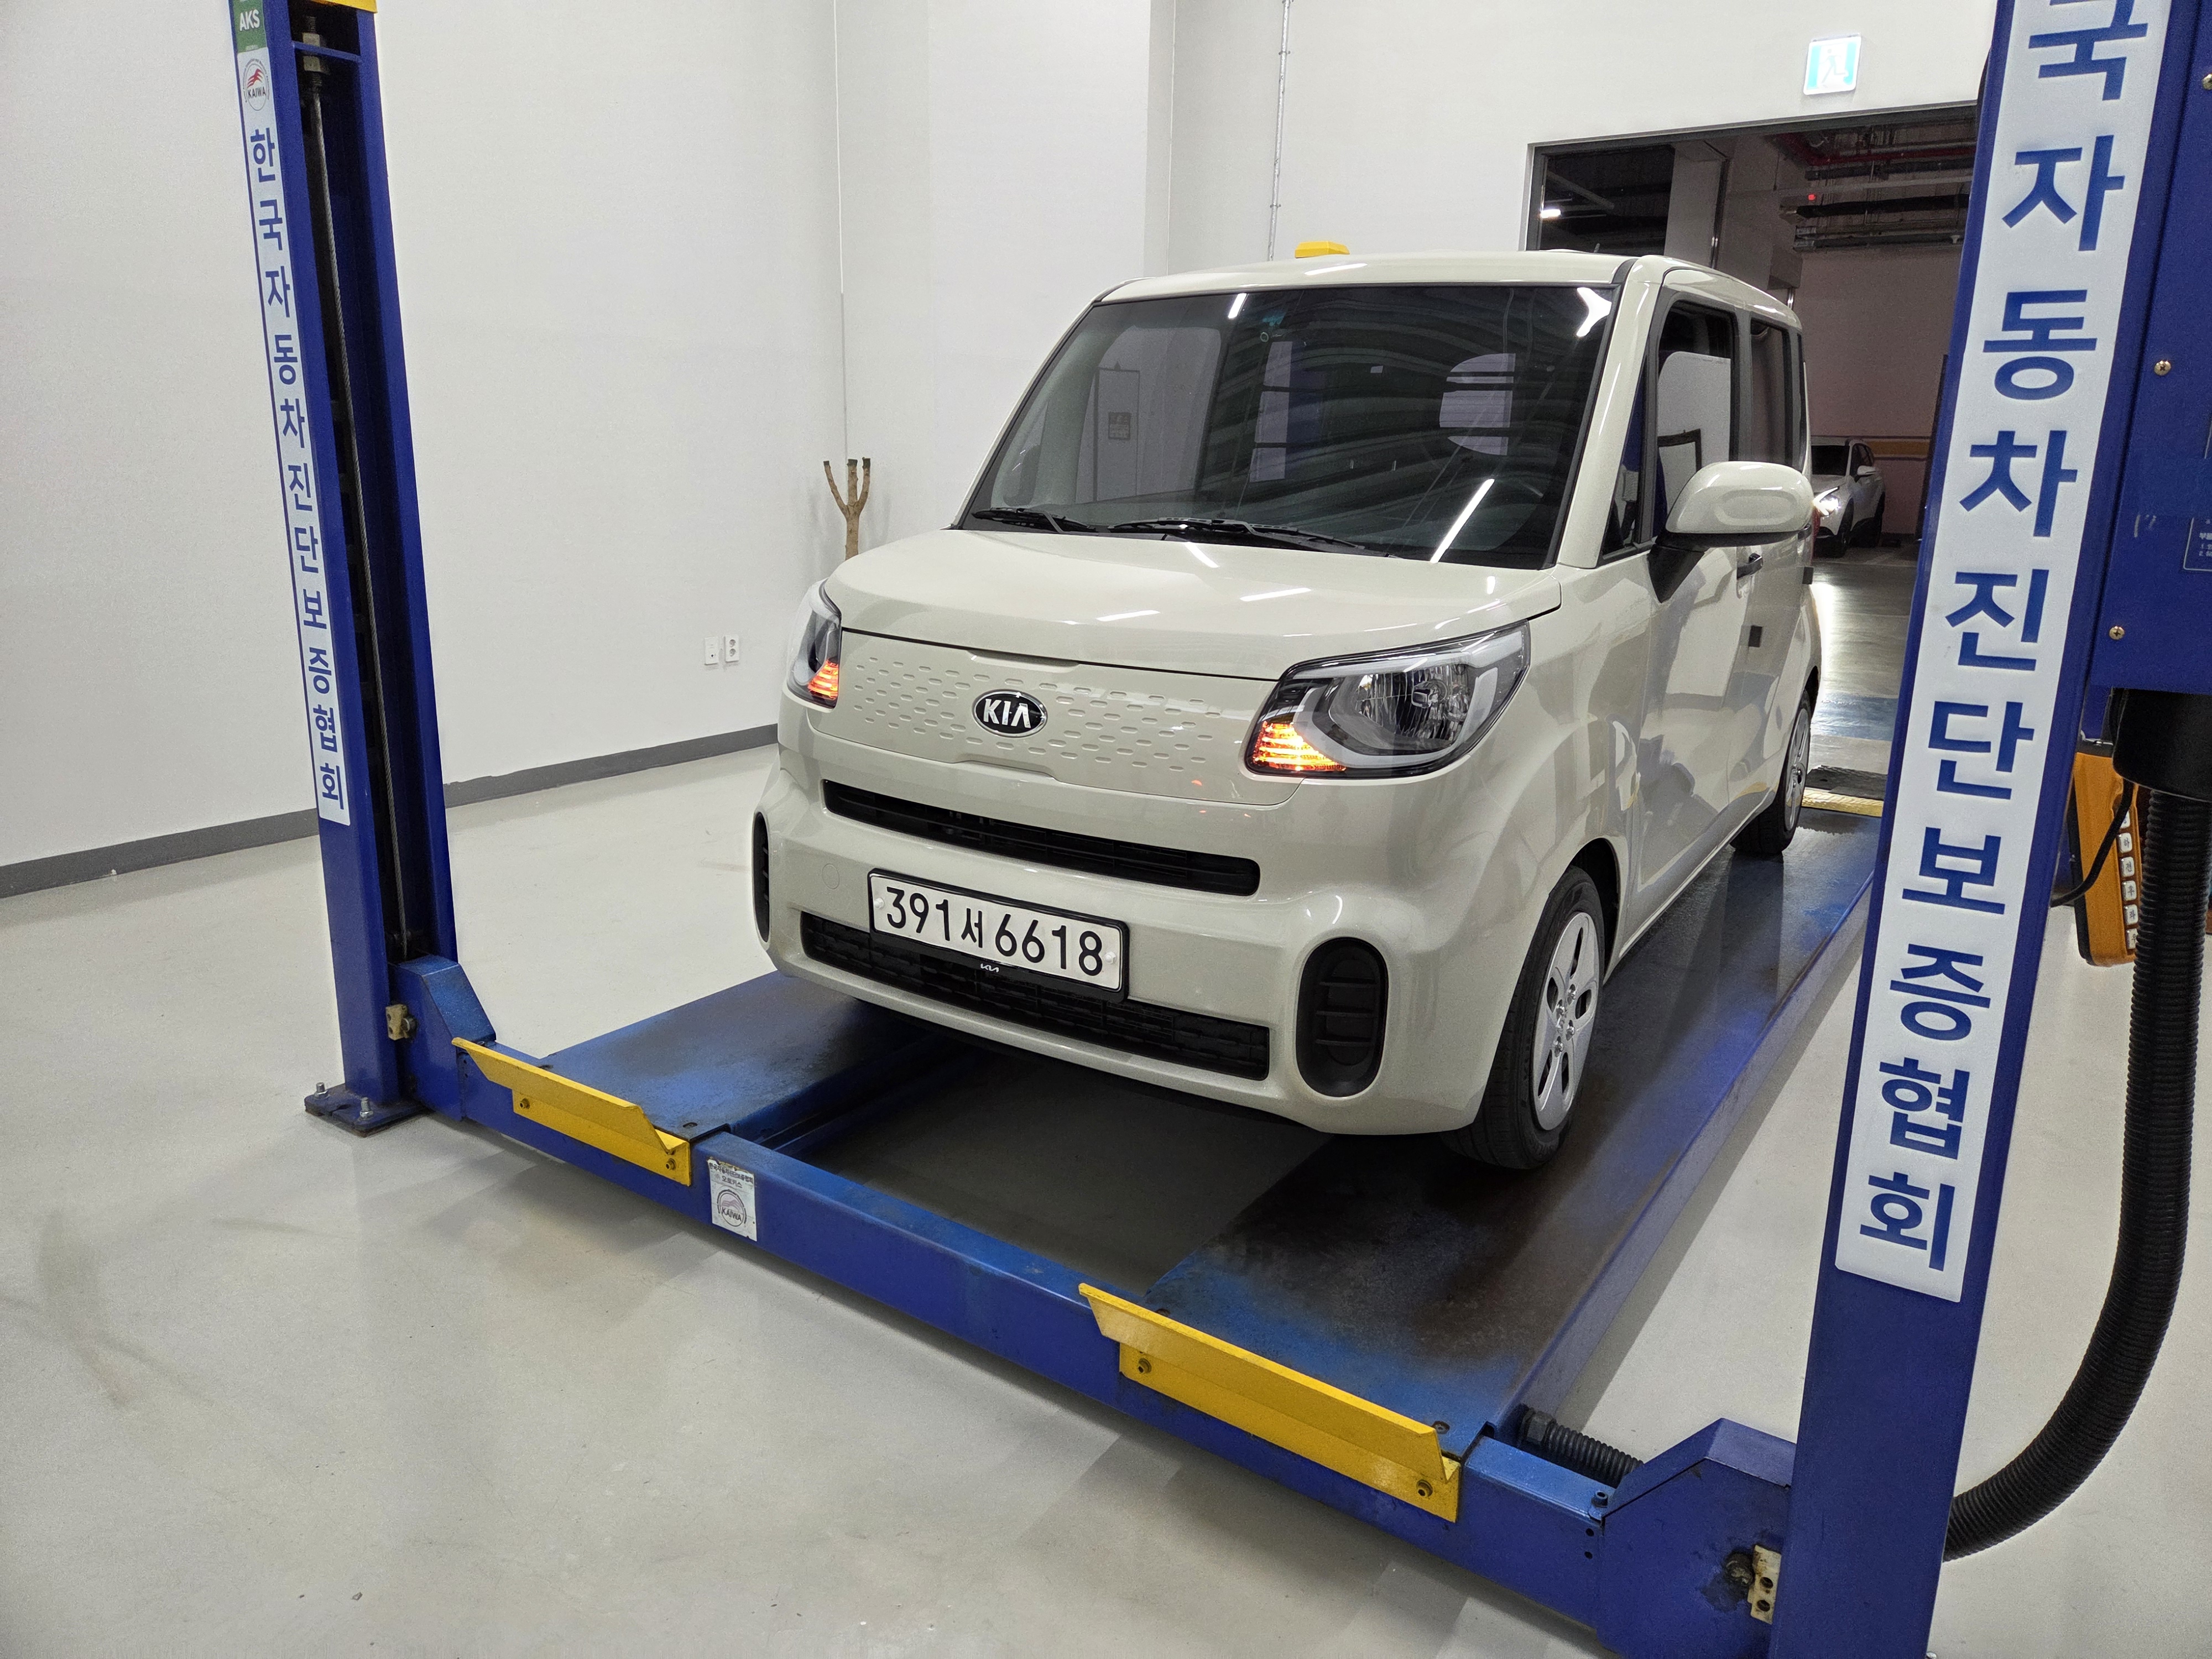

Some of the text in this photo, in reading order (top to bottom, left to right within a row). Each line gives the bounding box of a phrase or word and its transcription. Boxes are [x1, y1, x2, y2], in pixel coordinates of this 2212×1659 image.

[239, 8, 260, 32] AKS
[247, 86, 267, 99] KAIWA
[250, 127, 345, 810] 한국자동차진단보증협회
[983, 698, 1031, 728] KIA
[886, 886, 1103, 977] 391서6618
[722, 1206, 742, 1222] KAIWA
